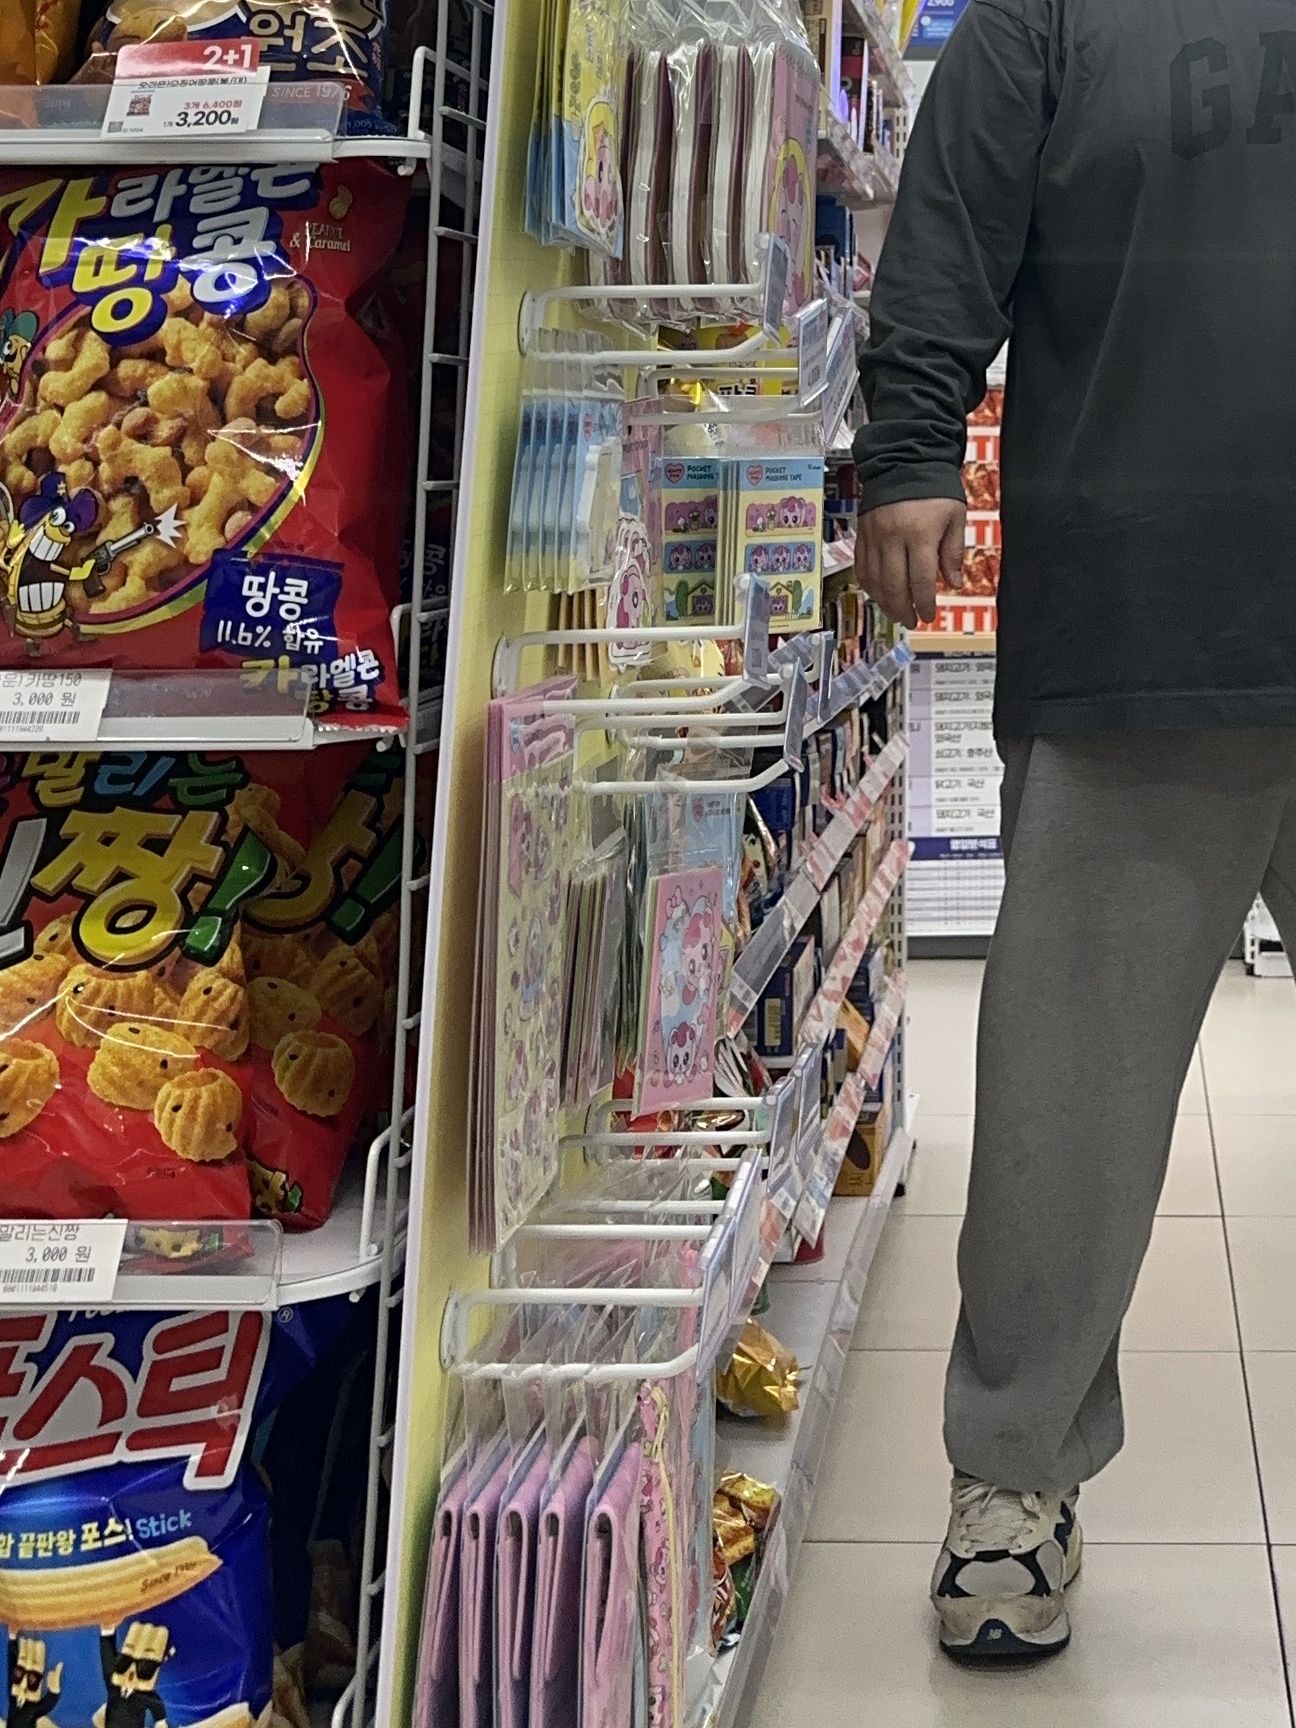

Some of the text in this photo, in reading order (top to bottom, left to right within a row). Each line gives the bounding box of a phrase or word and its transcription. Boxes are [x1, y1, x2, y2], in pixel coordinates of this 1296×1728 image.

[202, 44, 253, 70] 2+1
[272, 85, 311, 99] SINCE
[70, 207, 278, 334] 땅콩
[241, 572, 308, 620] 땅콩
[217, 620, 272, 648] 11.6%
[12, 692, 77, 707] 3,000 원
[25, 1245, 91, 1263] 3,000 원
[18, 1526, 76, 1559] 끝판왕
[80, 1517, 134, 1553] 포스!
[137, 1508, 193, 1540] Stick
